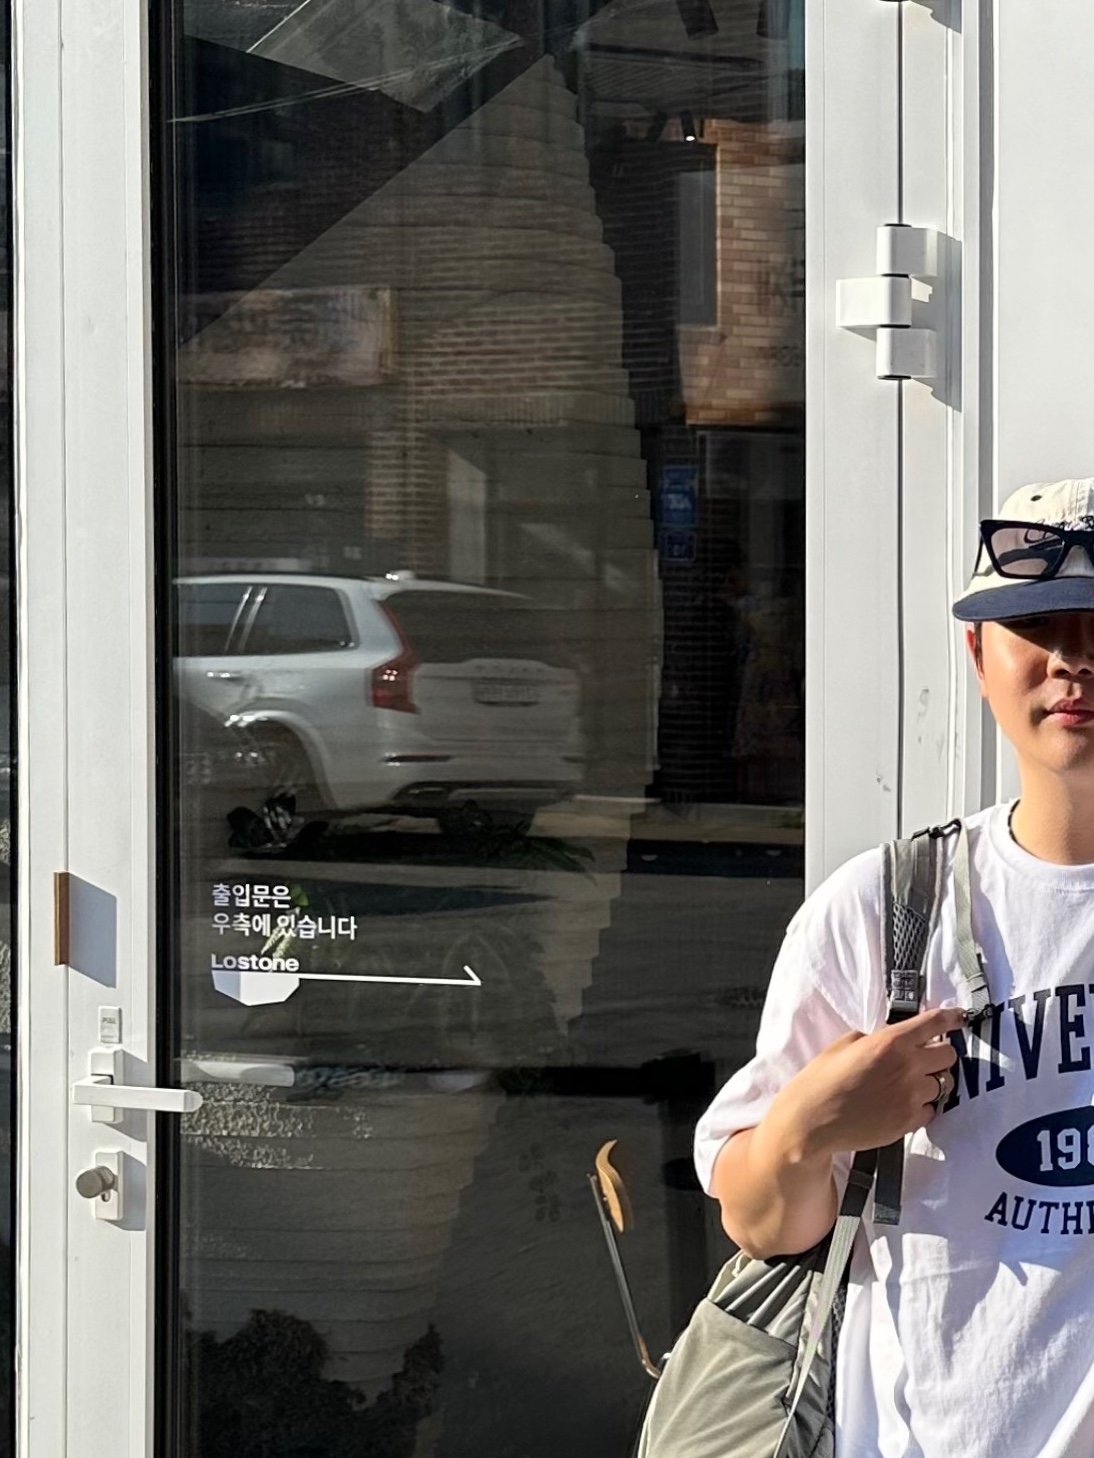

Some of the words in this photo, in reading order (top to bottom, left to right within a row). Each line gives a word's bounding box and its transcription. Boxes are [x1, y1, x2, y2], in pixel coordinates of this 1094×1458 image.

[212, 883, 291, 908] 출입문은
[212, 912, 271, 937] 우측에
[276, 914, 358, 940] 있습니다
[211, 953, 299, 972] Lostone
